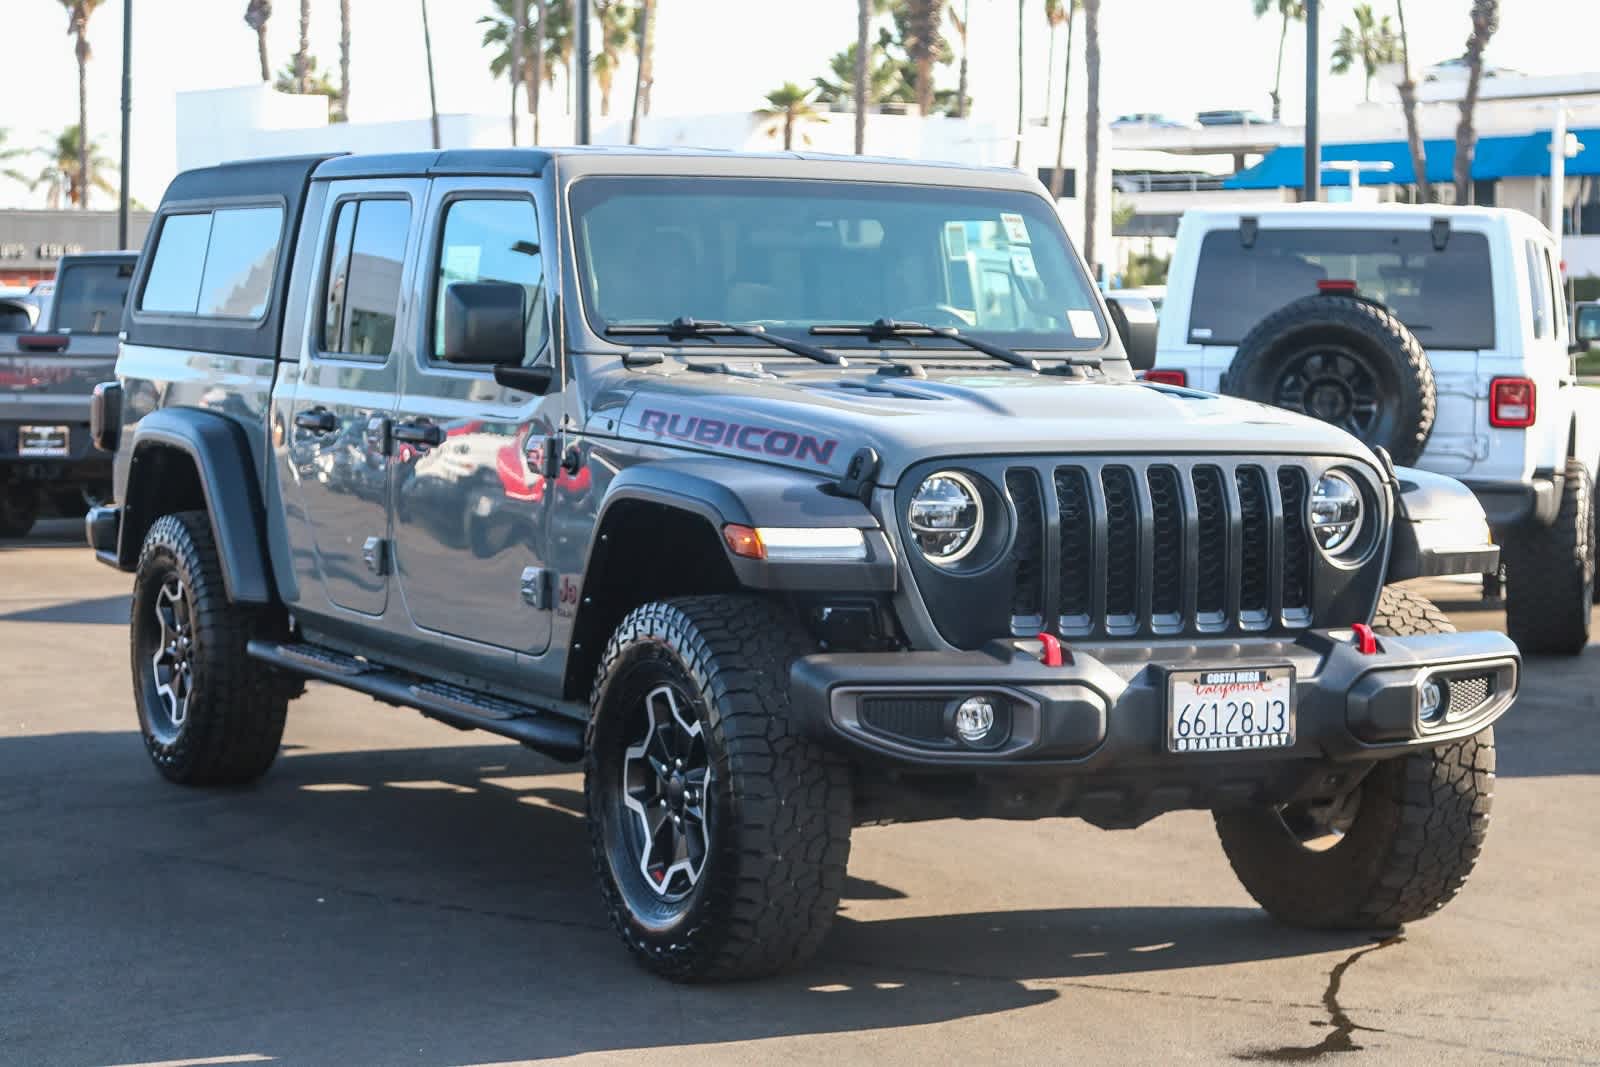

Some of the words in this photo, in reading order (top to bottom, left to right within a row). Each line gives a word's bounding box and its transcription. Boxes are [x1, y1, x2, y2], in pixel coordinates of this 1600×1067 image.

[638, 409, 839, 465] RUBICON
[1206, 672, 1235, 684] COSTA
[1236, 671, 1260, 683] MESA
[1194, 682, 1272, 699] California
[1178, 700, 1285, 736] 66128J3
[1178, 736, 1237, 751] ORANGE
[1242, 733, 1288, 748] COAST
